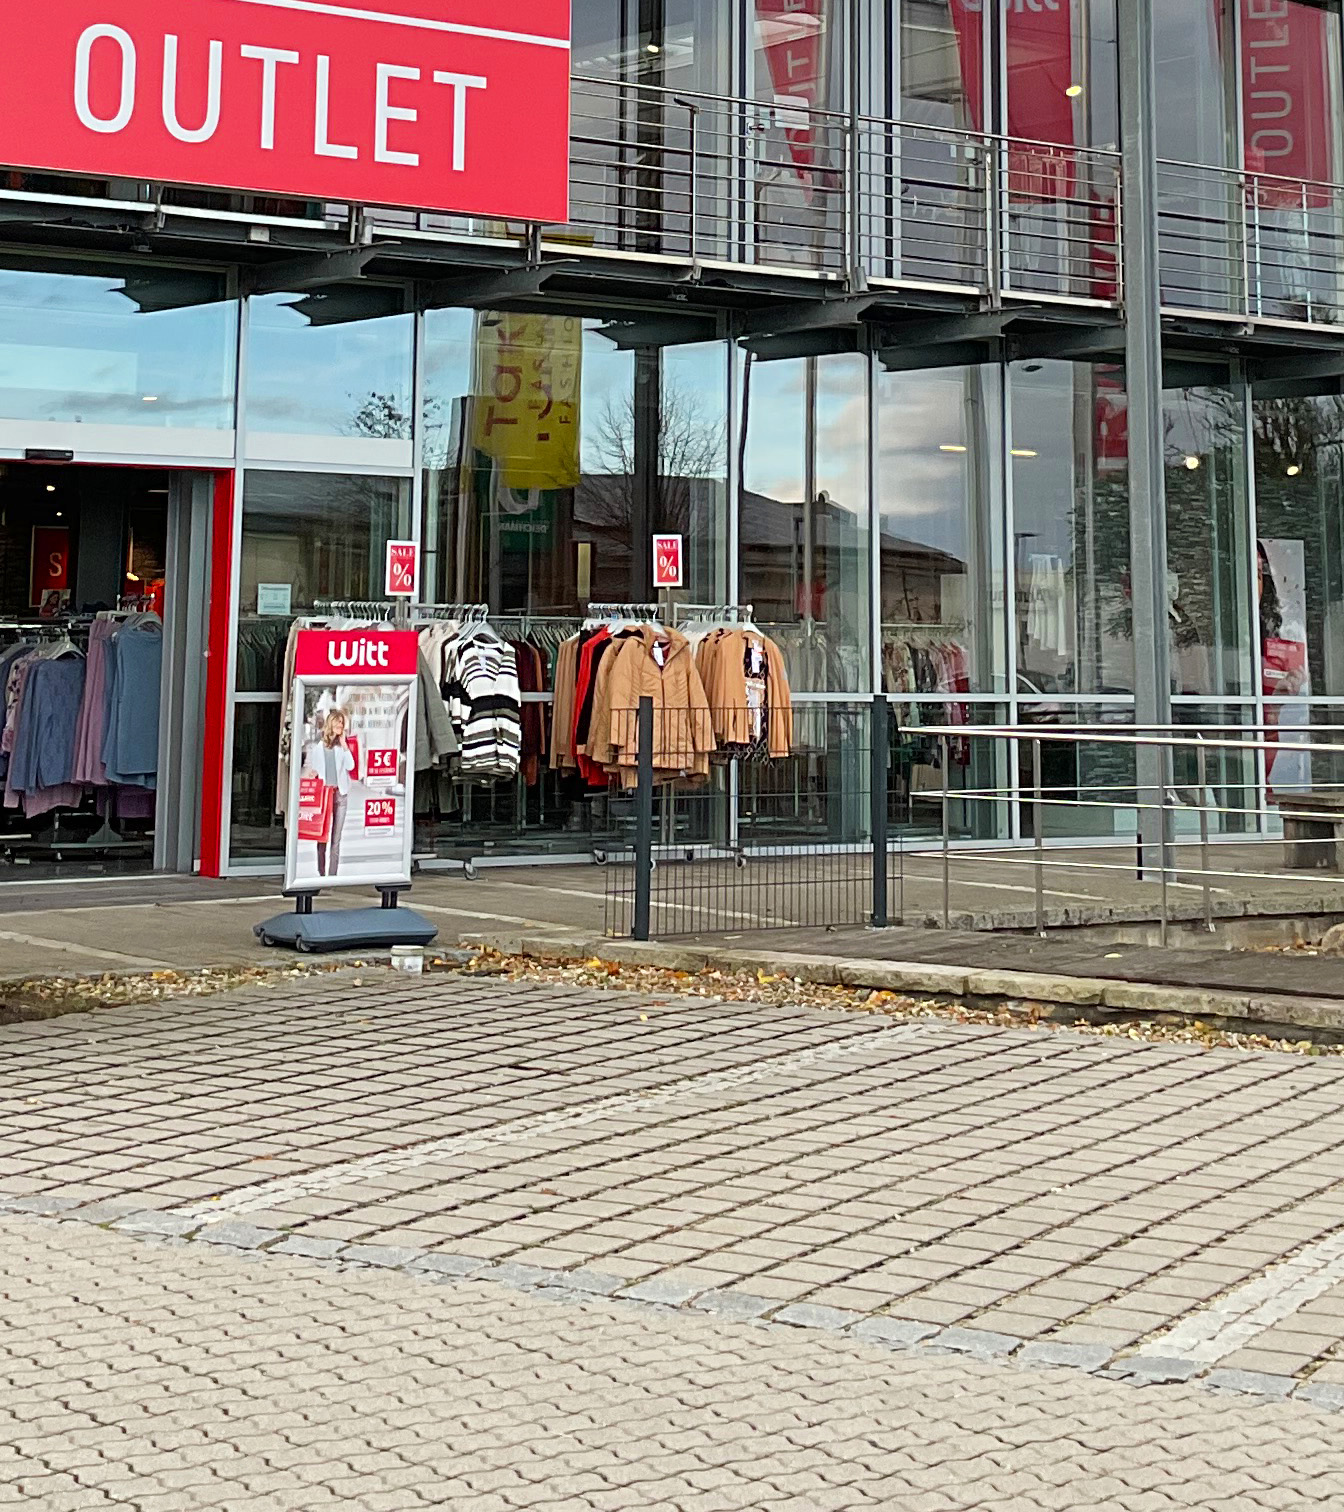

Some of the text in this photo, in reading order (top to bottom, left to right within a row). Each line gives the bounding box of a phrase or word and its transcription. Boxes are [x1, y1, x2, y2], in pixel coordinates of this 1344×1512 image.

[74, 23, 487, 171] OUTLET
[657, 540, 679, 550] SALE
[391, 547, 415, 557] SALE
